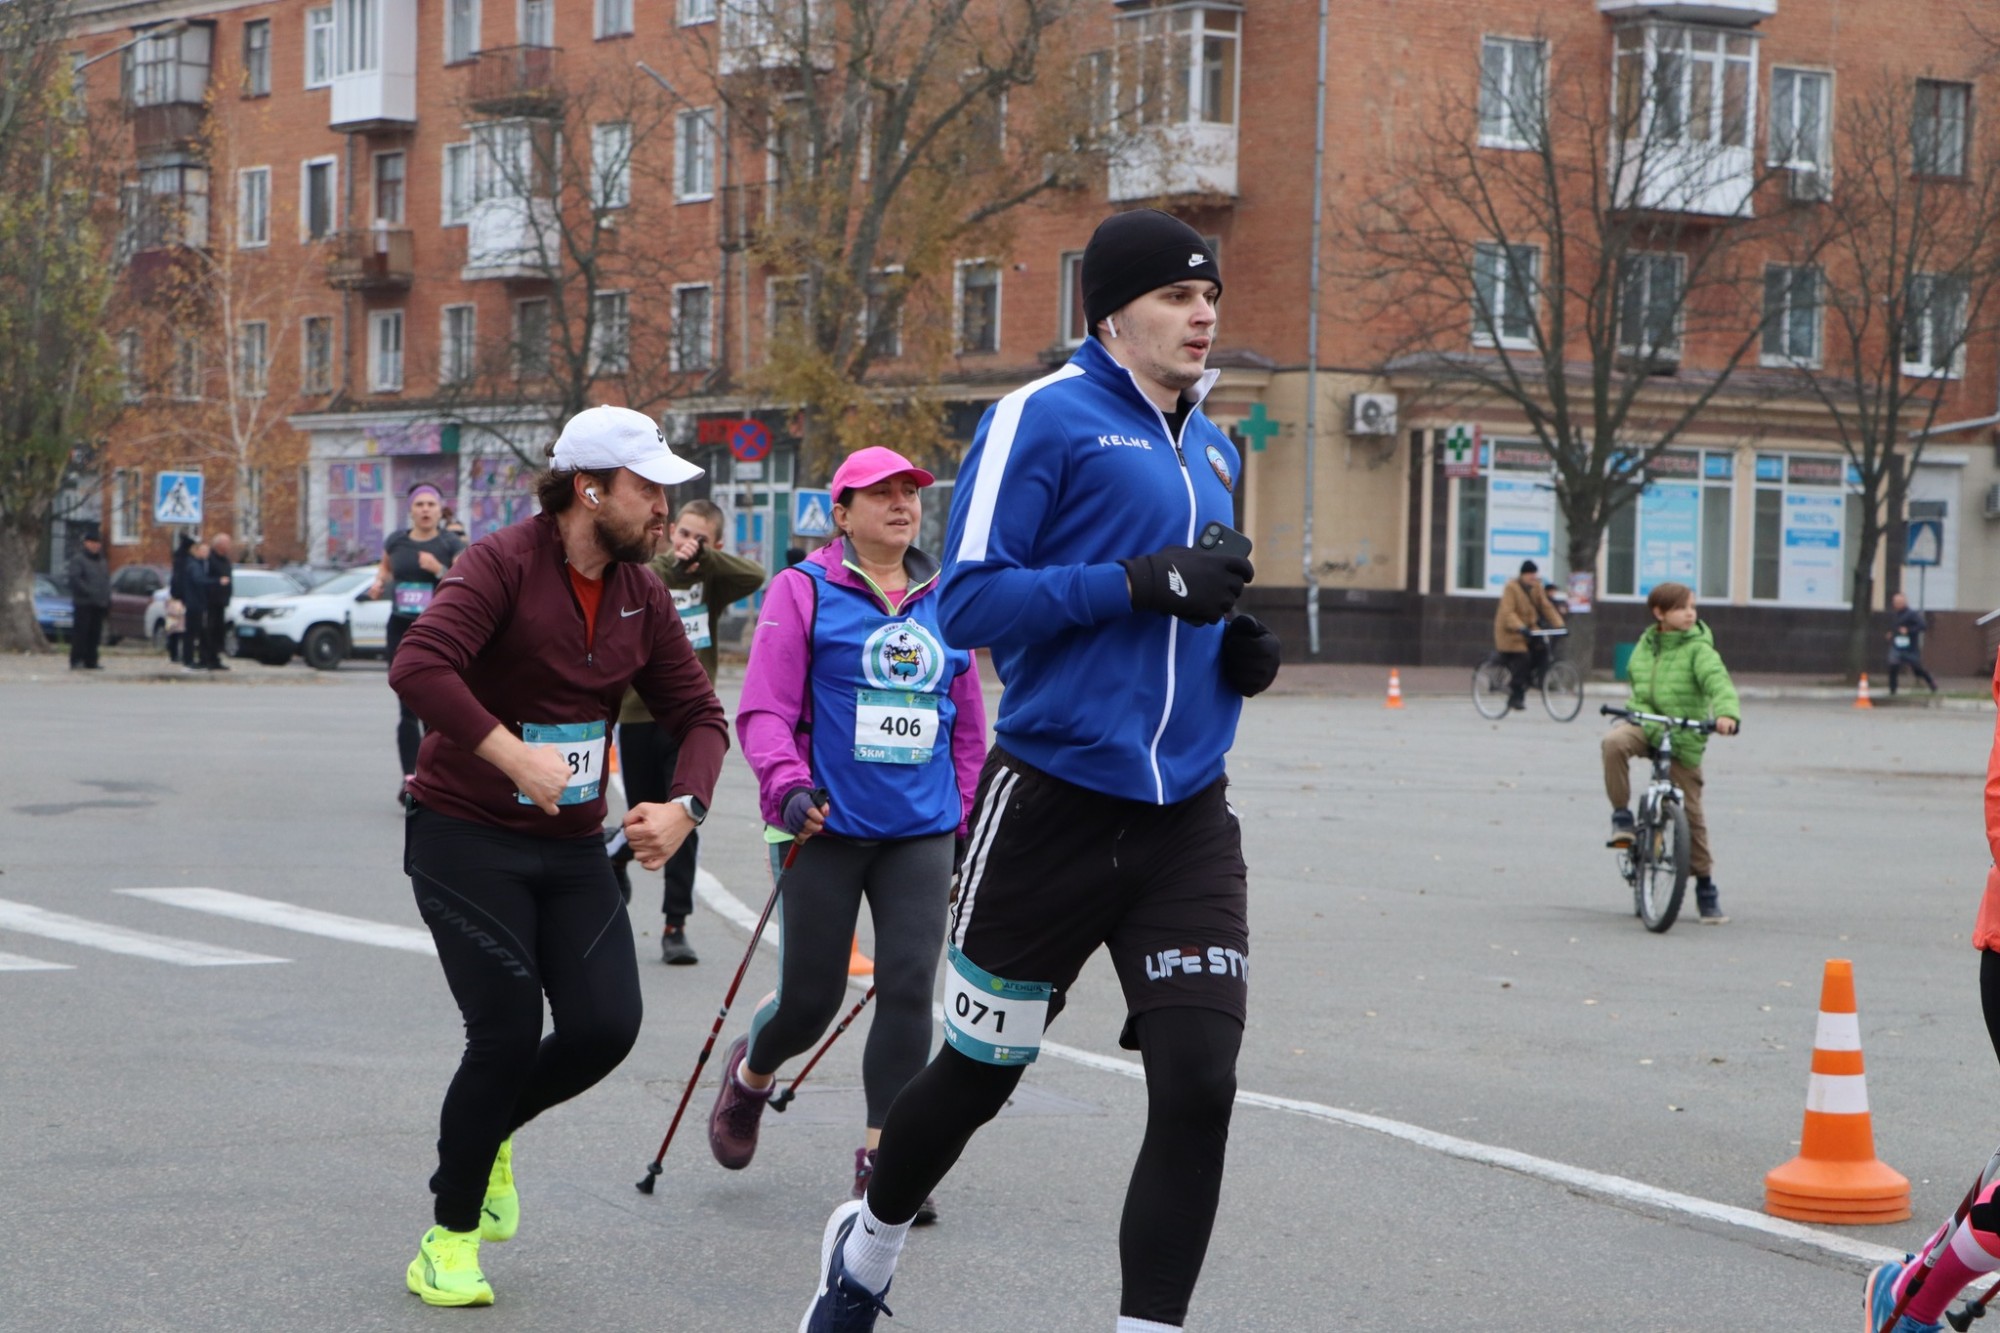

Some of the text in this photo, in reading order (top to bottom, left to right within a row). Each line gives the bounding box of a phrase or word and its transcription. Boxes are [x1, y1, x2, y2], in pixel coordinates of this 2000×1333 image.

[1098, 435, 1152, 450] KELME
[1168, 570, 1182, 594] NIKE
[685, 621, 699, 634] 94
[880, 716, 921, 737] 406
[567, 750, 590, 775] 81
[859, 746, 885, 758] 5KM
[423, 897, 531, 979] DYNAFIT
[1145, 947, 1202, 981] LIFE
[955, 992, 1006, 1033] 071
